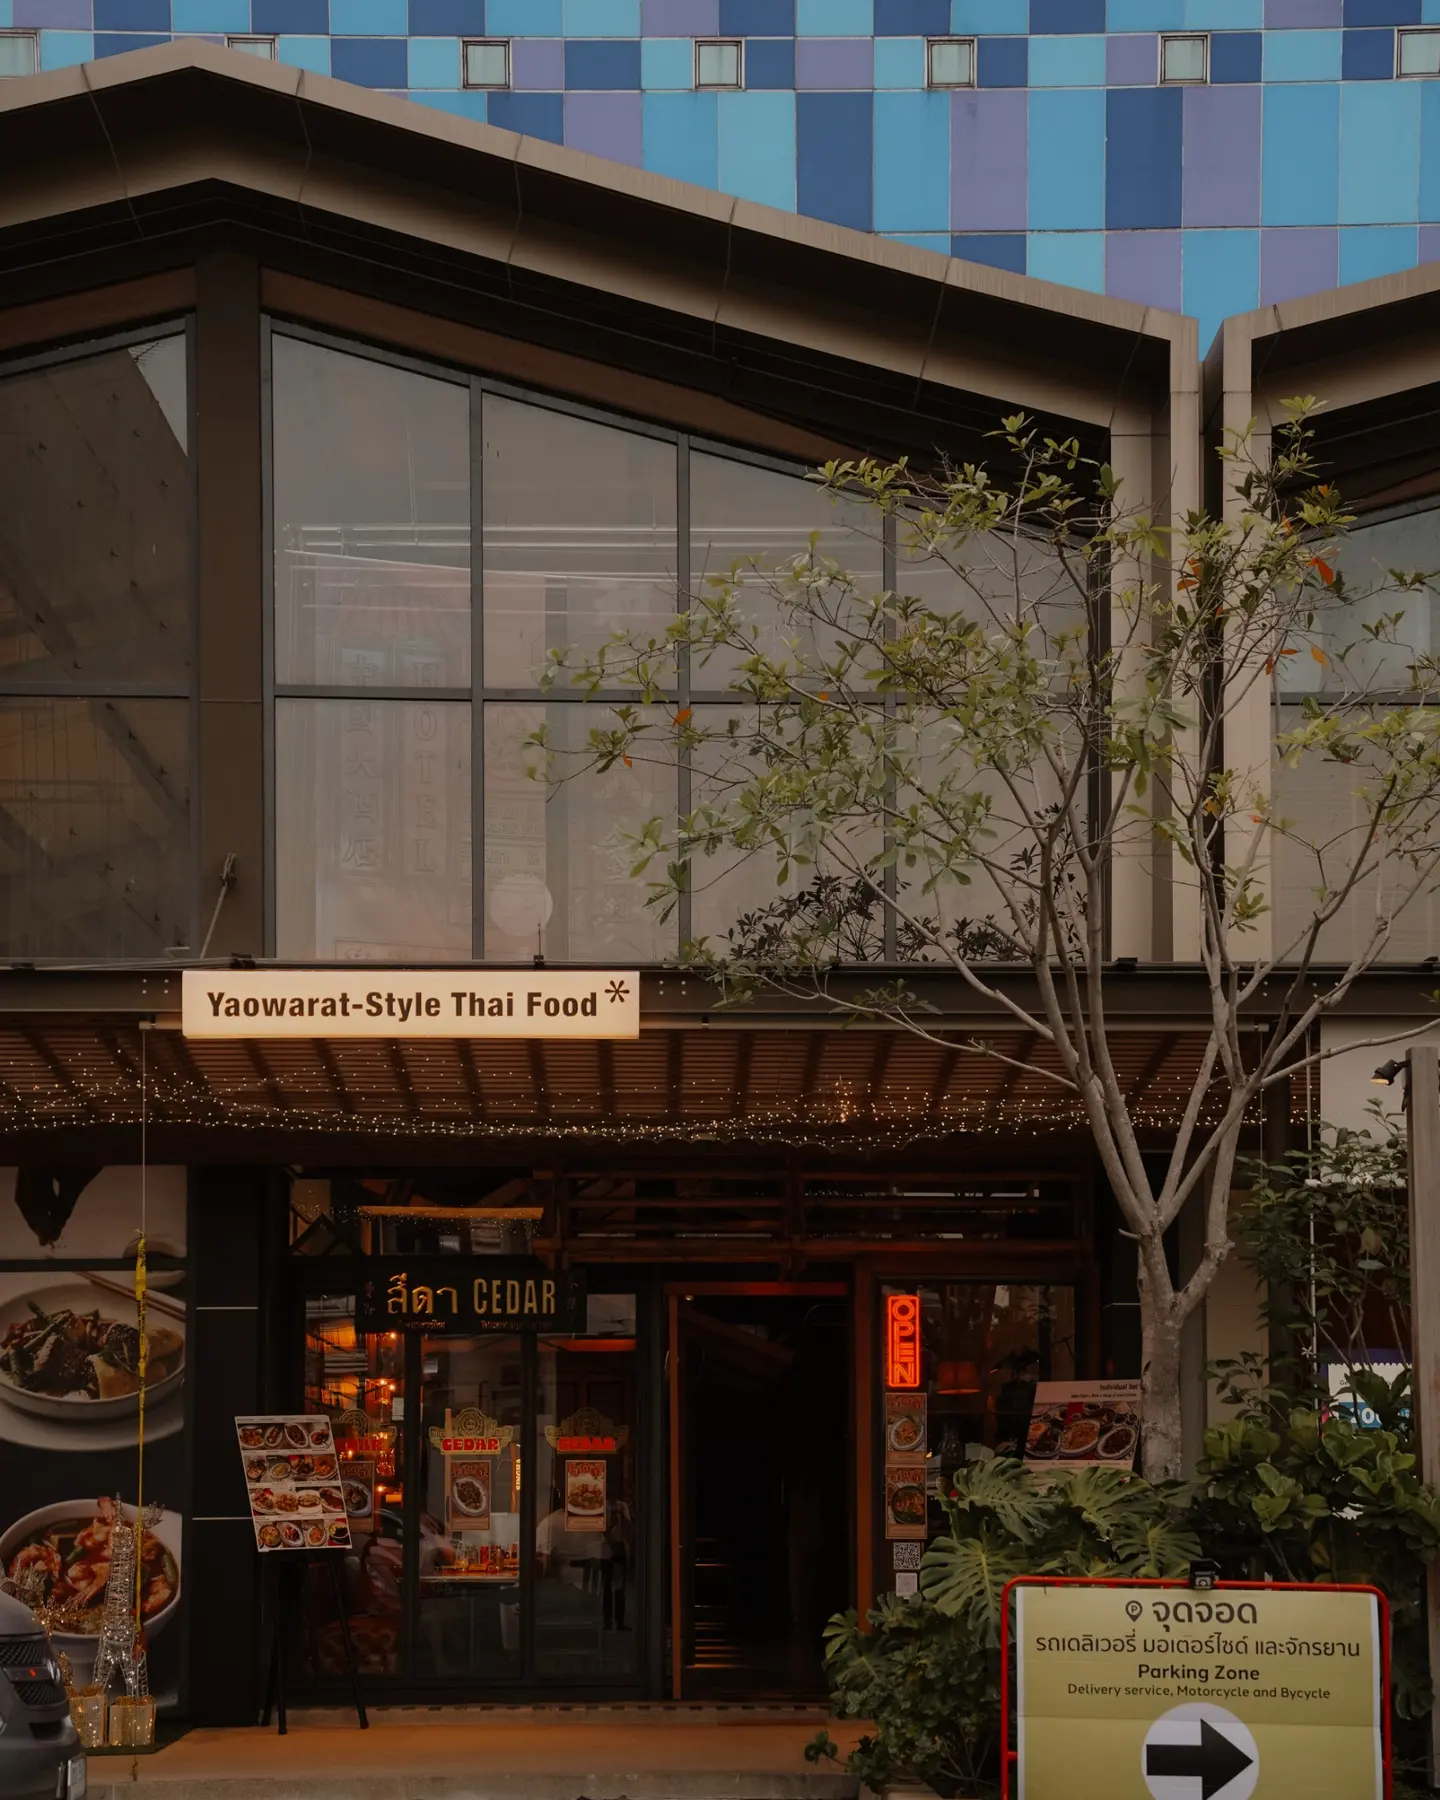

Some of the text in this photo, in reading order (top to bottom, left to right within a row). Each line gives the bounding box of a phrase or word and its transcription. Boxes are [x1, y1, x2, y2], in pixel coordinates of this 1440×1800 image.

[208, 992, 597, 1022] Yaowarat-Style Thai Food
[387, 1272, 459, 1314] สีดา
[473, 1278, 556, 1314] CEDAR
[892, 1299, 916, 1384] OPEN
[441, 1438, 500, 1452] CEDAR
[1152, 1601, 1258, 1633] จุดจอด
[1036, 1629, 1360, 1657] รถเดลิเวอรี่ มอเตอร์ไซด์ และจักรยาน
[1138, 1663, 1260, 1683] Parking Zone
[1067, 1683, 1331, 1701] Delivery service, Motorcycle and Bycycle
